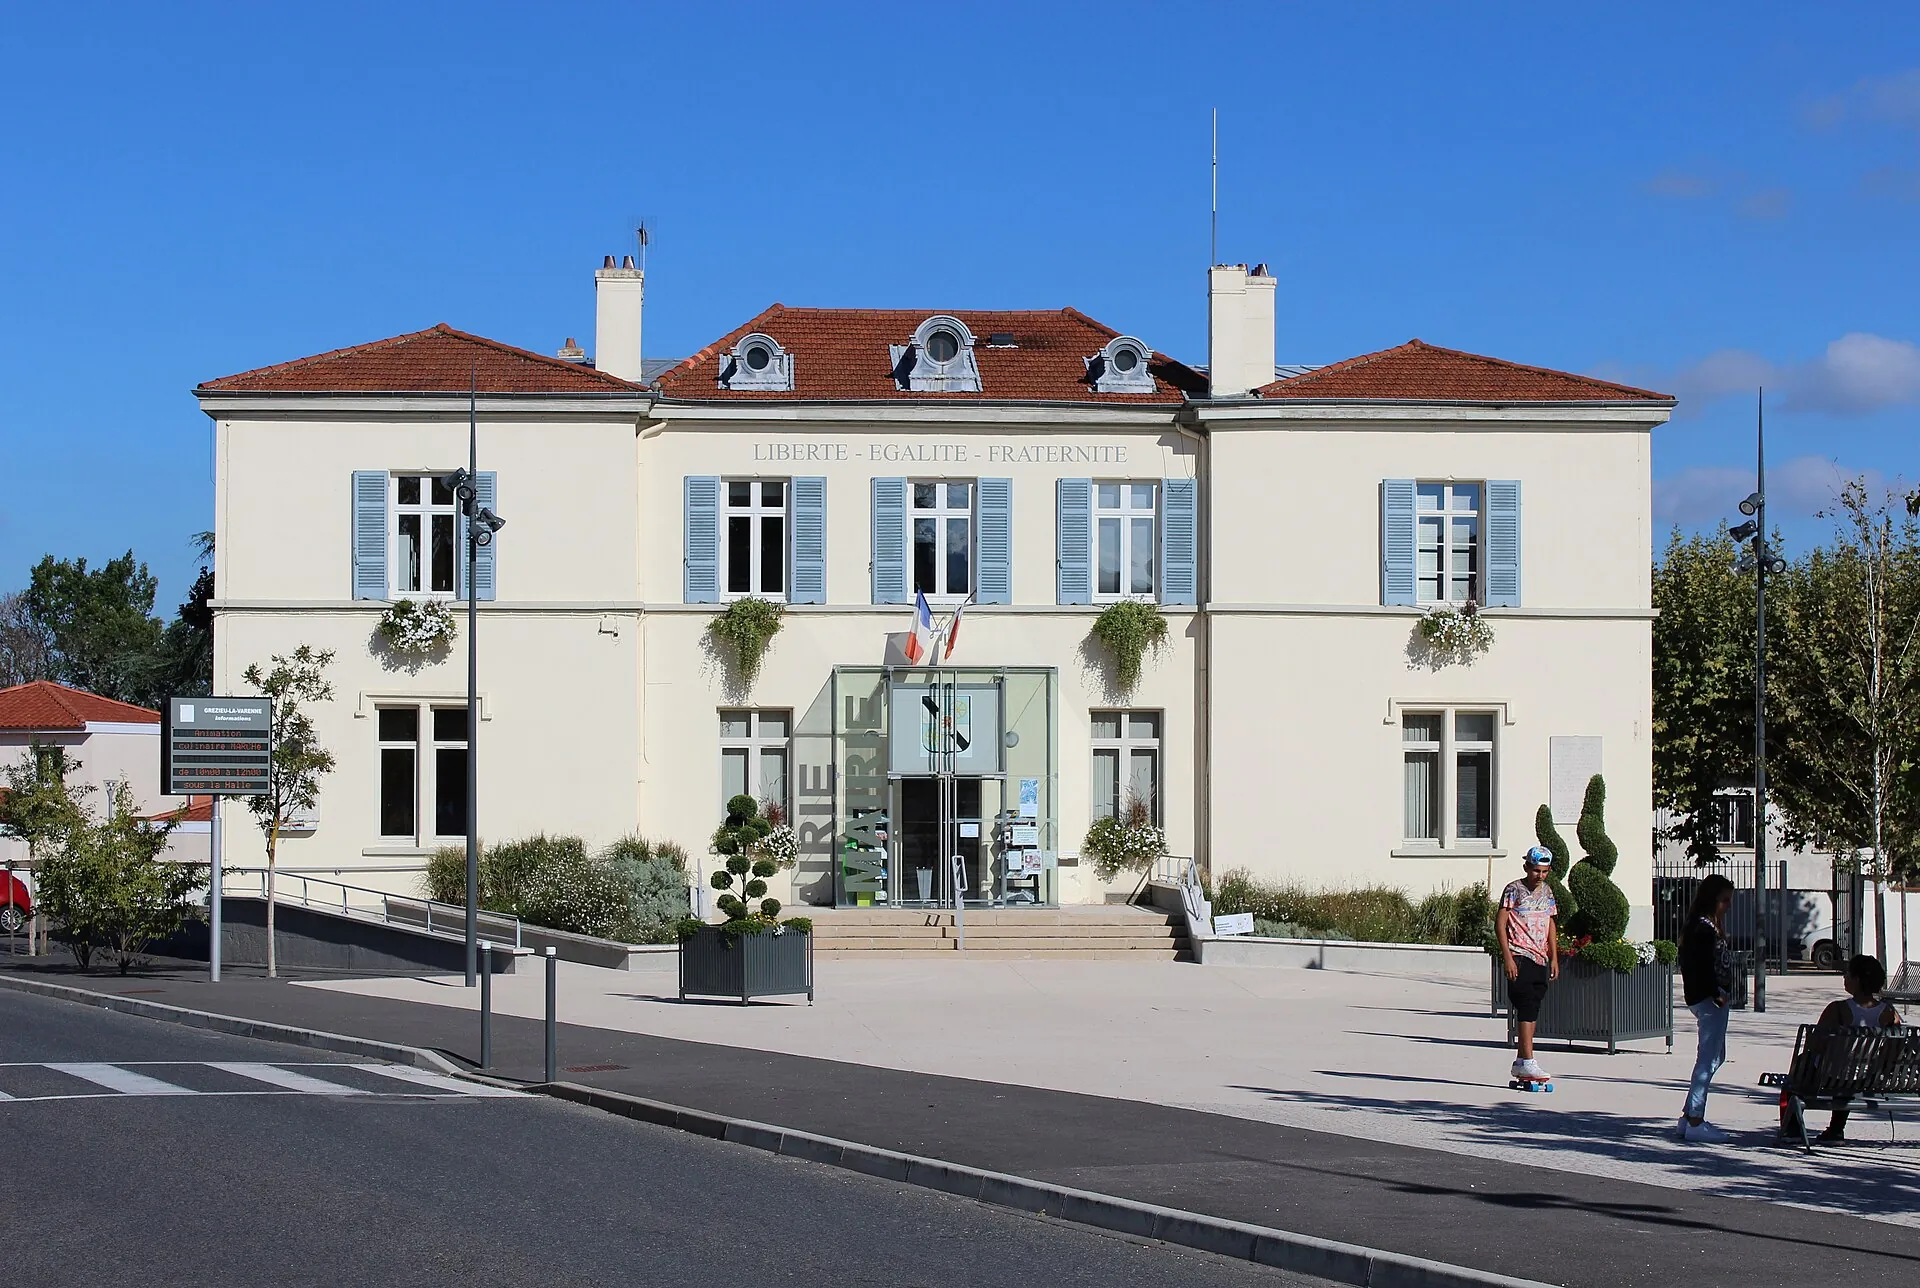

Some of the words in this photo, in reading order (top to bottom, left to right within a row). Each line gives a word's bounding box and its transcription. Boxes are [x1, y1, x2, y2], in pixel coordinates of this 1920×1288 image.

[753, 443, 849, 461] LIBERTE
[868, 444, 968, 462] EGALITE
[988, 445, 1129, 463] FRATERNITE
[178, 742, 226, 750] culinaire
[178, 768, 190, 776] de
[183, 781, 205, 789] sous
[210, 781, 221, 789] la
[224, 781, 252, 789] Halle
[845, 696, 882, 892] MAIRIE
